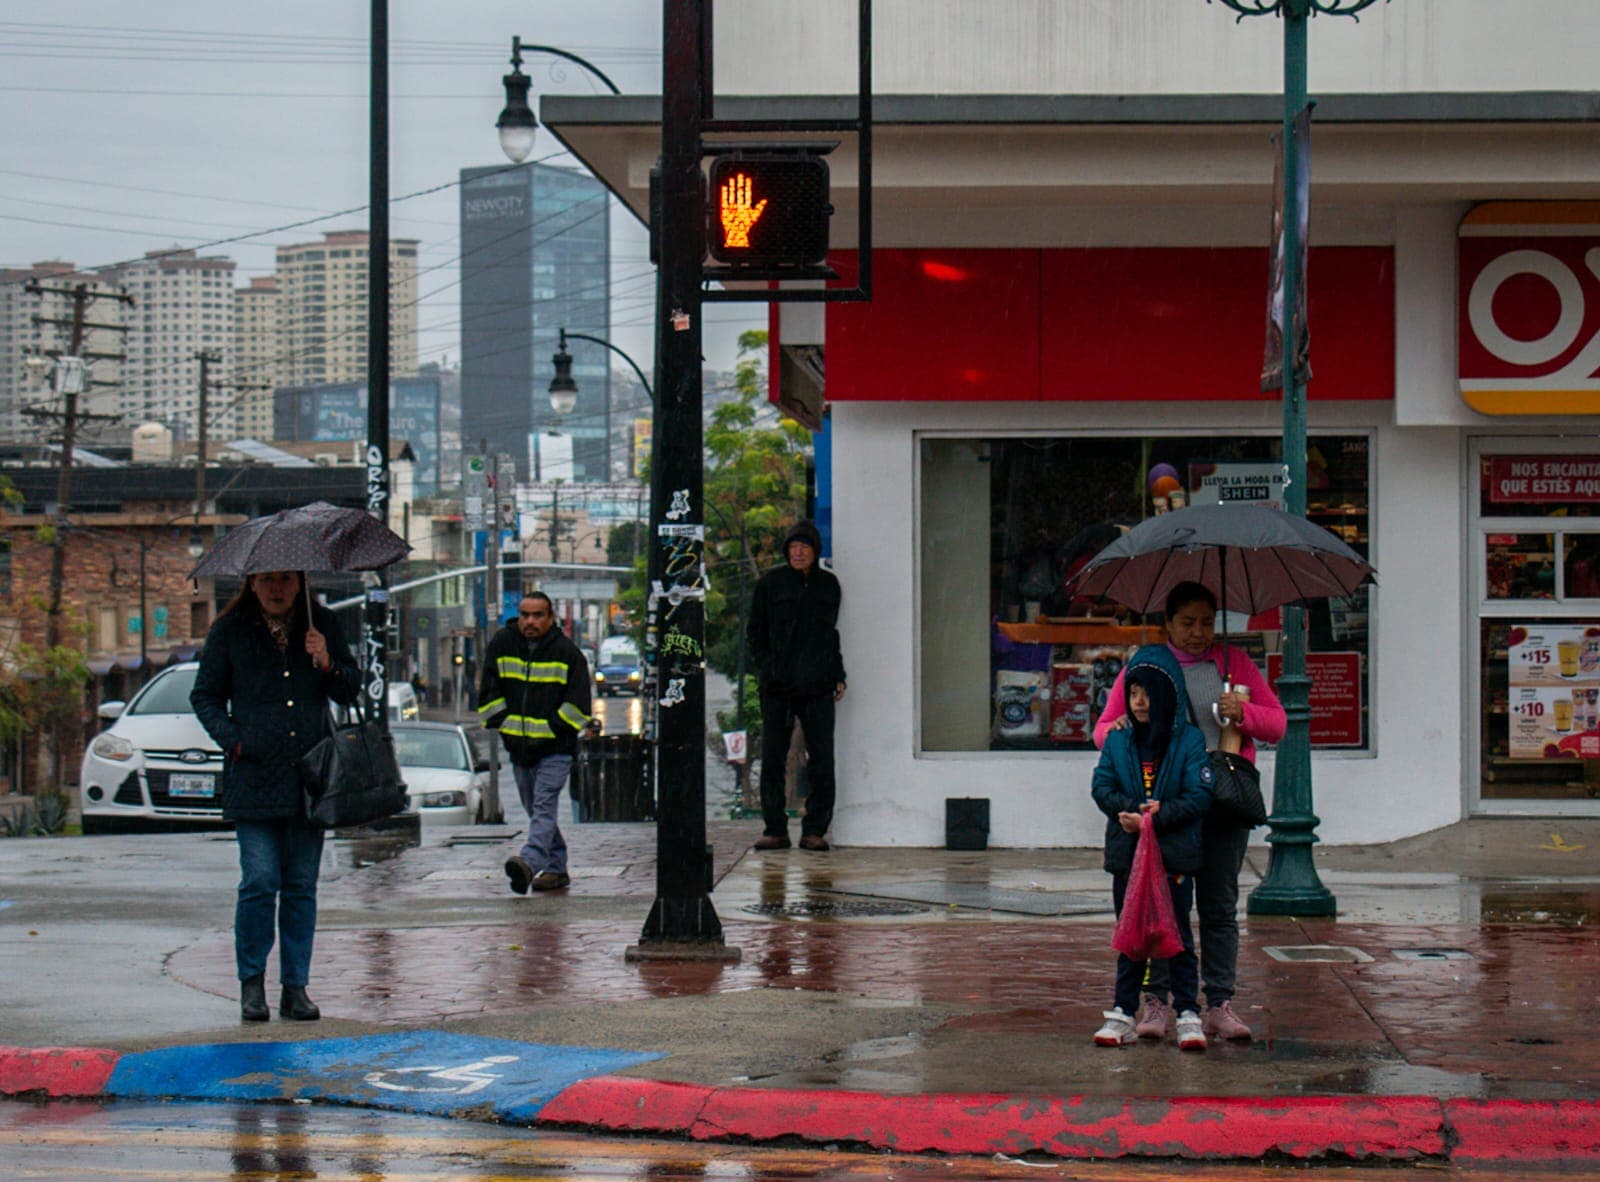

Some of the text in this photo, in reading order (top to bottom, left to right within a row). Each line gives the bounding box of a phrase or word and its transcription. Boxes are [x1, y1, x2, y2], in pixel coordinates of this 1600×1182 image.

[1511, 462, 1539, 477] NOS
[1231, 476, 1242, 486] LA
[1244, 475, 1270, 485] MODA
[1501, 479, 1529, 496] QUE
[1532, 477, 1571, 494] ESTÉS
[1223, 486, 1267, 499] SHEIN
